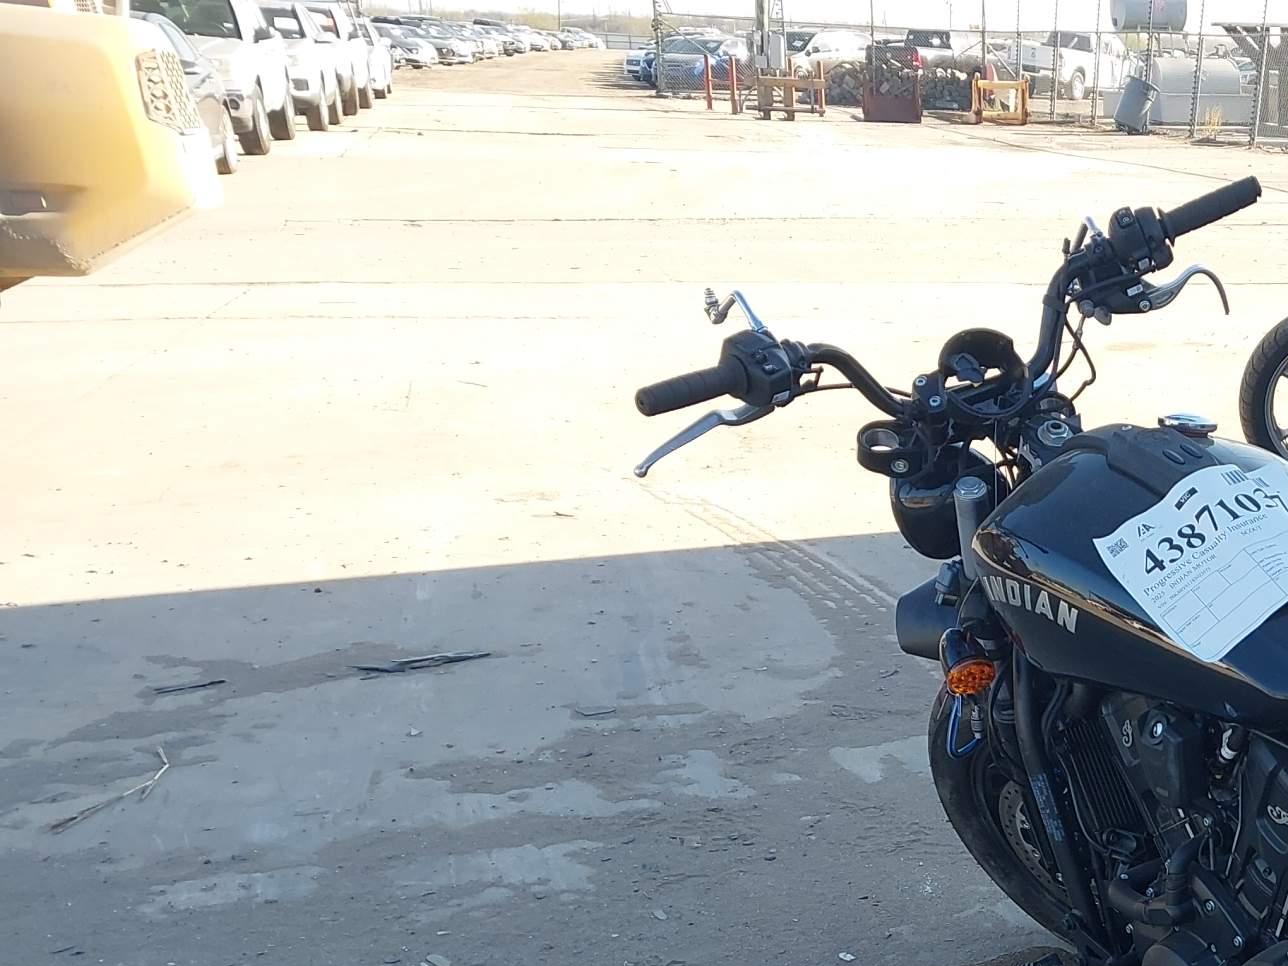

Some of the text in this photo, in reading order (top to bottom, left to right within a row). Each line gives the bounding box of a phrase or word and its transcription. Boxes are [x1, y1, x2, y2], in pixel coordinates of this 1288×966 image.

[1143, 559, 1193, 597] Progressive
[1191, 531, 1227, 560] Casualty
[1226, 512, 1269, 533] Insurance
[1168, 569, 1193, 590] INDIAN
[982, 575, 1079, 634] INDIAN
